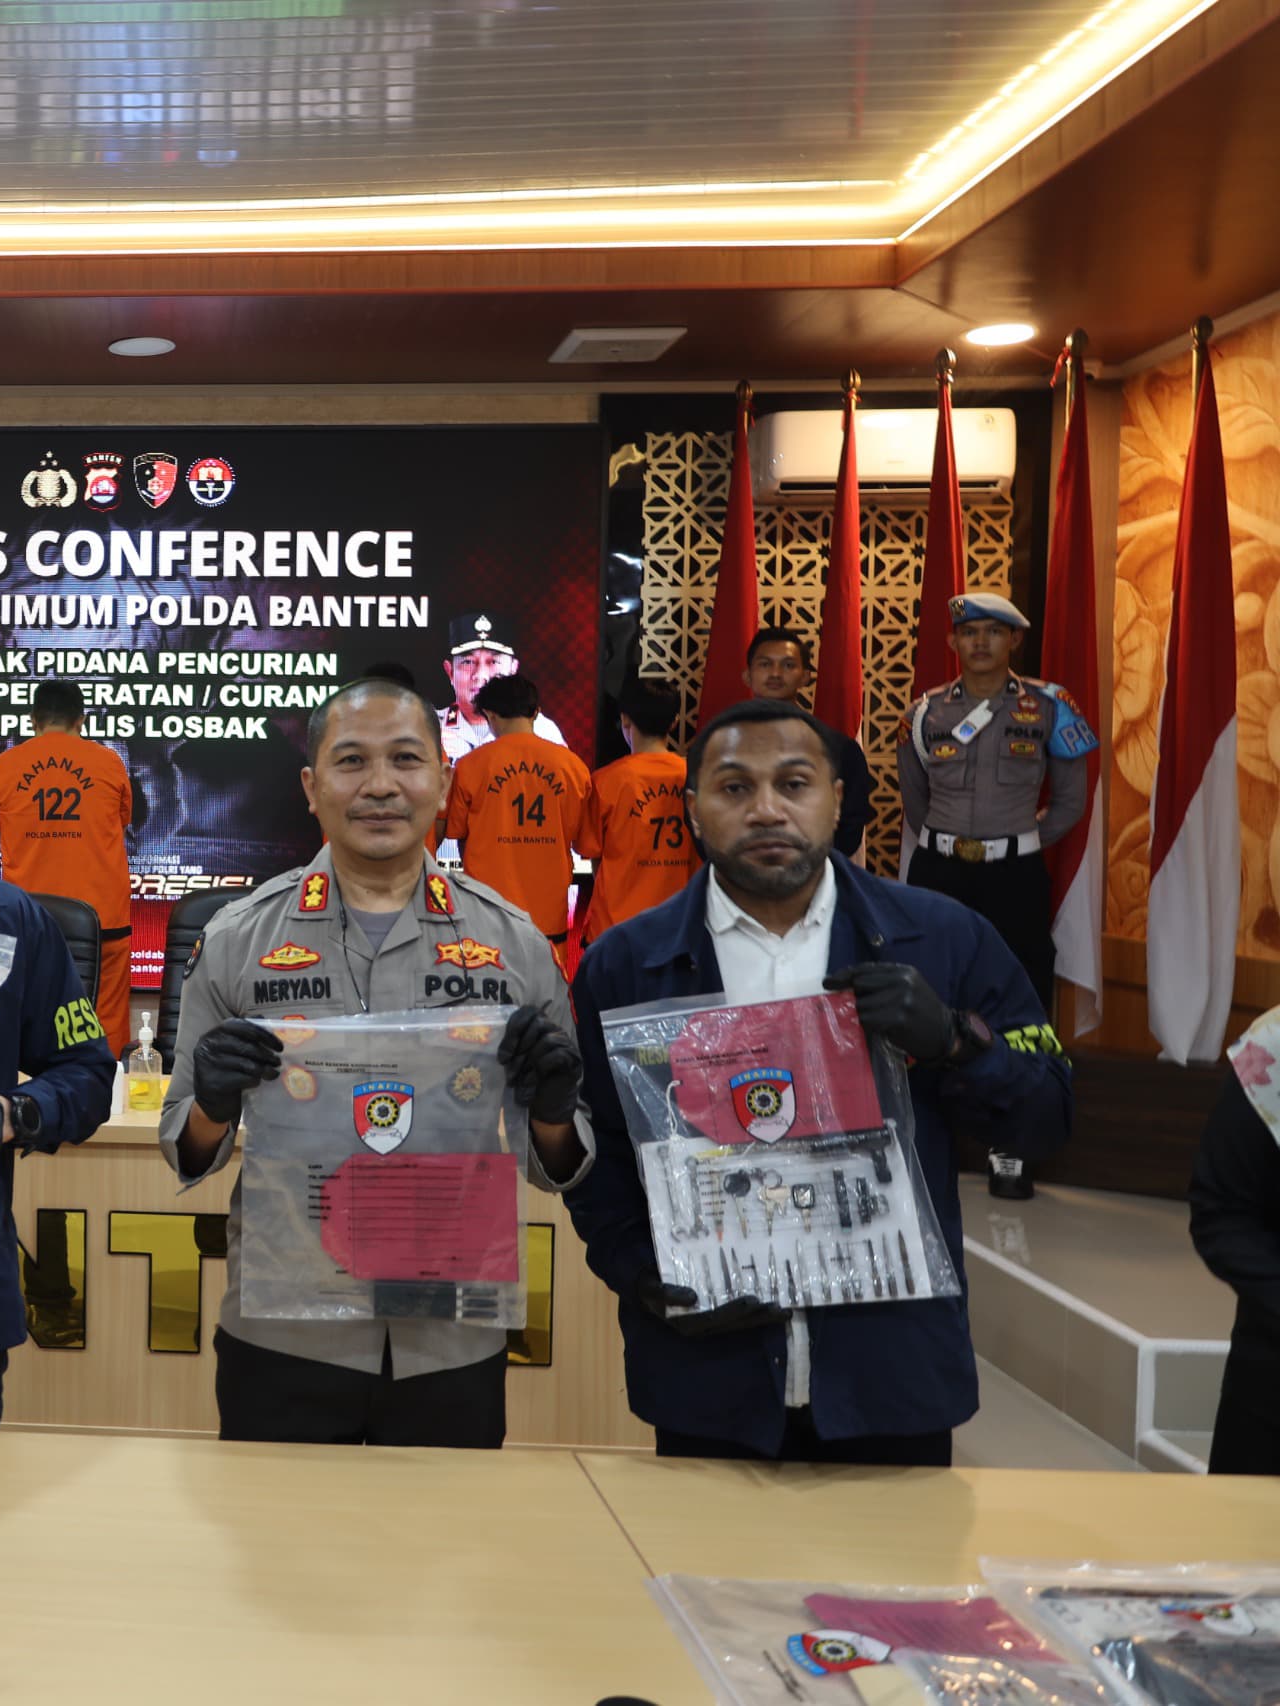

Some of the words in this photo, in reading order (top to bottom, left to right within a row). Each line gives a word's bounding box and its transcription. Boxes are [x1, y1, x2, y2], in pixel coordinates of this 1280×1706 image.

[25, 530, 414, 578] CONFERENCE
[127, 594, 257, 627] POLDA
[269, 595, 429, 629] BANTEN
[37, 650, 149, 674] PIDANA
[158, 652, 338, 676] PENCURIAN
[144, 716, 268, 740] LOSBAK
[16, 756, 95, 792] TAHANAN
[487, 760, 566, 797] TAHANAN
[32, 787, 81, 821] 122
[511, 792, 546, 828] 14
[25, 831, 50, 839] POLDA
[52, 831, 82, 839] BANTEN
[497, 836, 522, 844] POLDA
[523, 836, 557, 845] BANTEN
[650, 815, 684, 851] 73
[179, 865, 203, 875] YANG
[253, 976, 331, 1005] MERYADI
[425, 974, 508, 1002] POLRI
